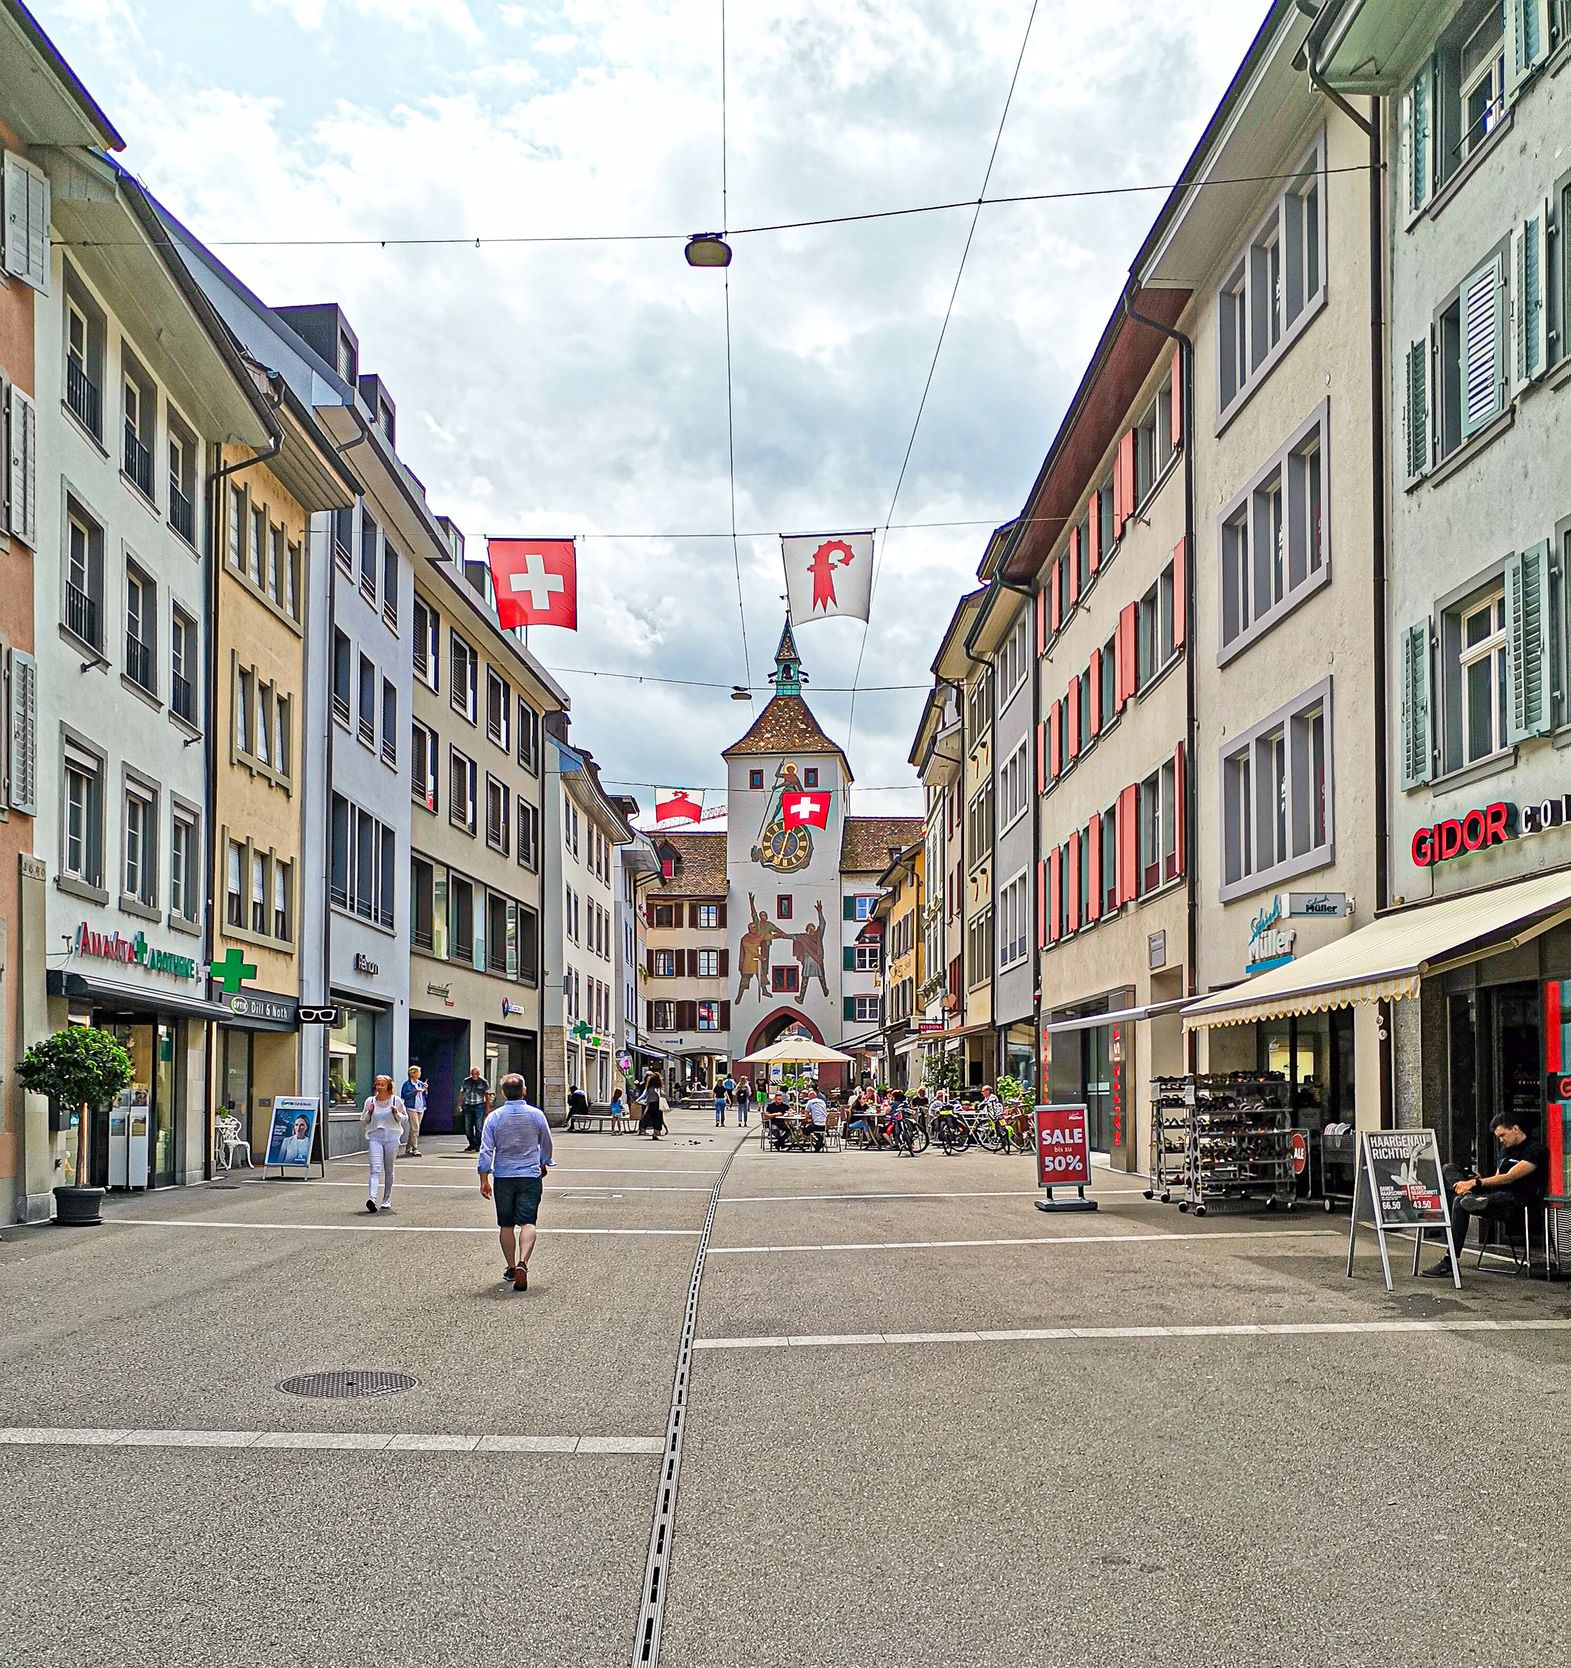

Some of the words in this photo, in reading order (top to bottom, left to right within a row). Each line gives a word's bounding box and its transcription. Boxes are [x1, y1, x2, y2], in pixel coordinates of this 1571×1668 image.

[1411, 801, 1510, 867] GIDOR
[1306, 904, 1338, 913] Müller
[251, 1001, 264, 1015] Dill
[265, 1004, 271, 1016] &
[272, 1005, 288, 1019] Noth
[1041, 1128, 1083, 1145] SALE
[1370, 1135, 1427, 1148] HAARGENAU
[1372, 1148, 1410, 1159] RICHTIG
[1044, 1154, 1083, 1172] 50%
[1382, 1201, 1401, 1210] 66.50
[1412, 1200, 1432, 1209] 43.50
